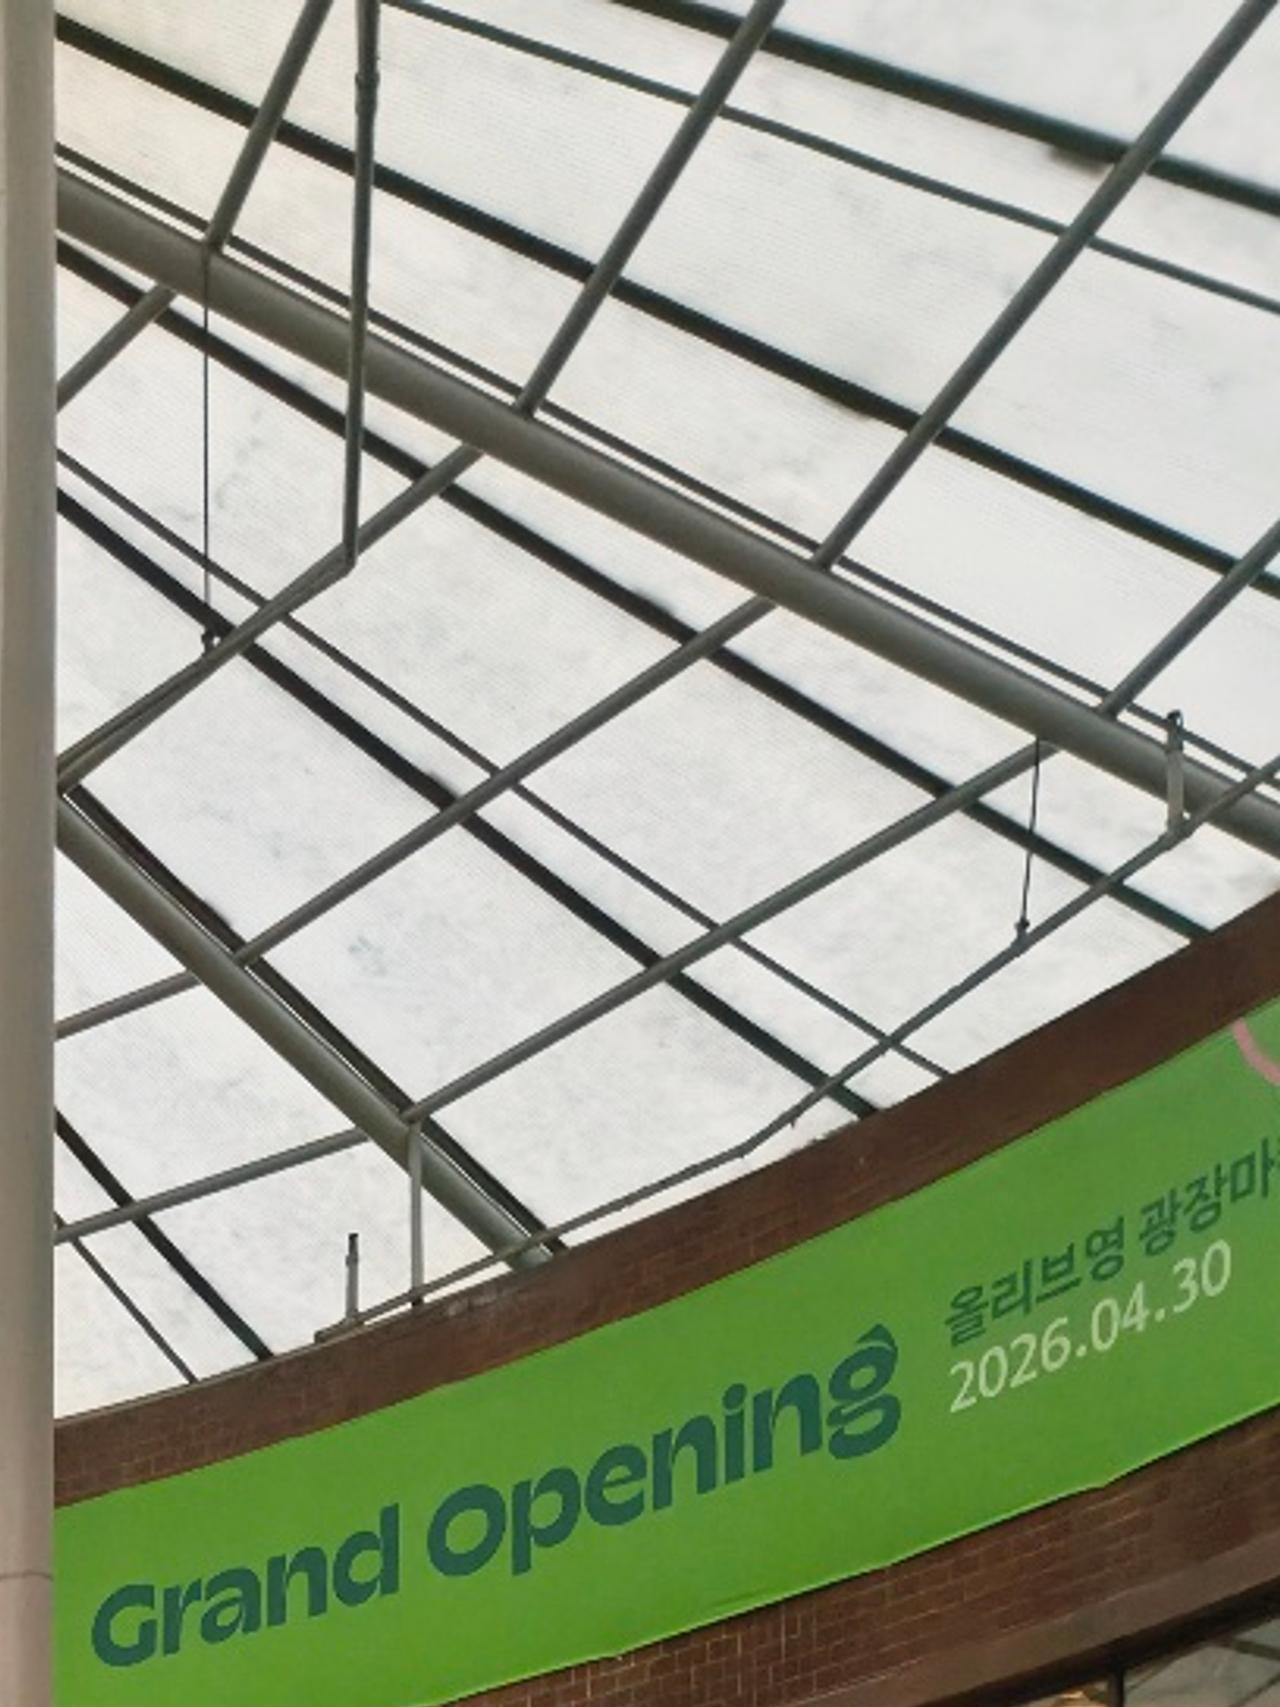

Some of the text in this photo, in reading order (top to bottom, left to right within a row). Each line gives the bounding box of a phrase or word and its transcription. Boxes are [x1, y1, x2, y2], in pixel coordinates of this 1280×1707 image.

[945, 1137, 1280, 1348] 올리브영 광장마
[950, 1239, 1231, 1413] 2026.04.30
[92, 1324, 901, 1666] Grand Opening
